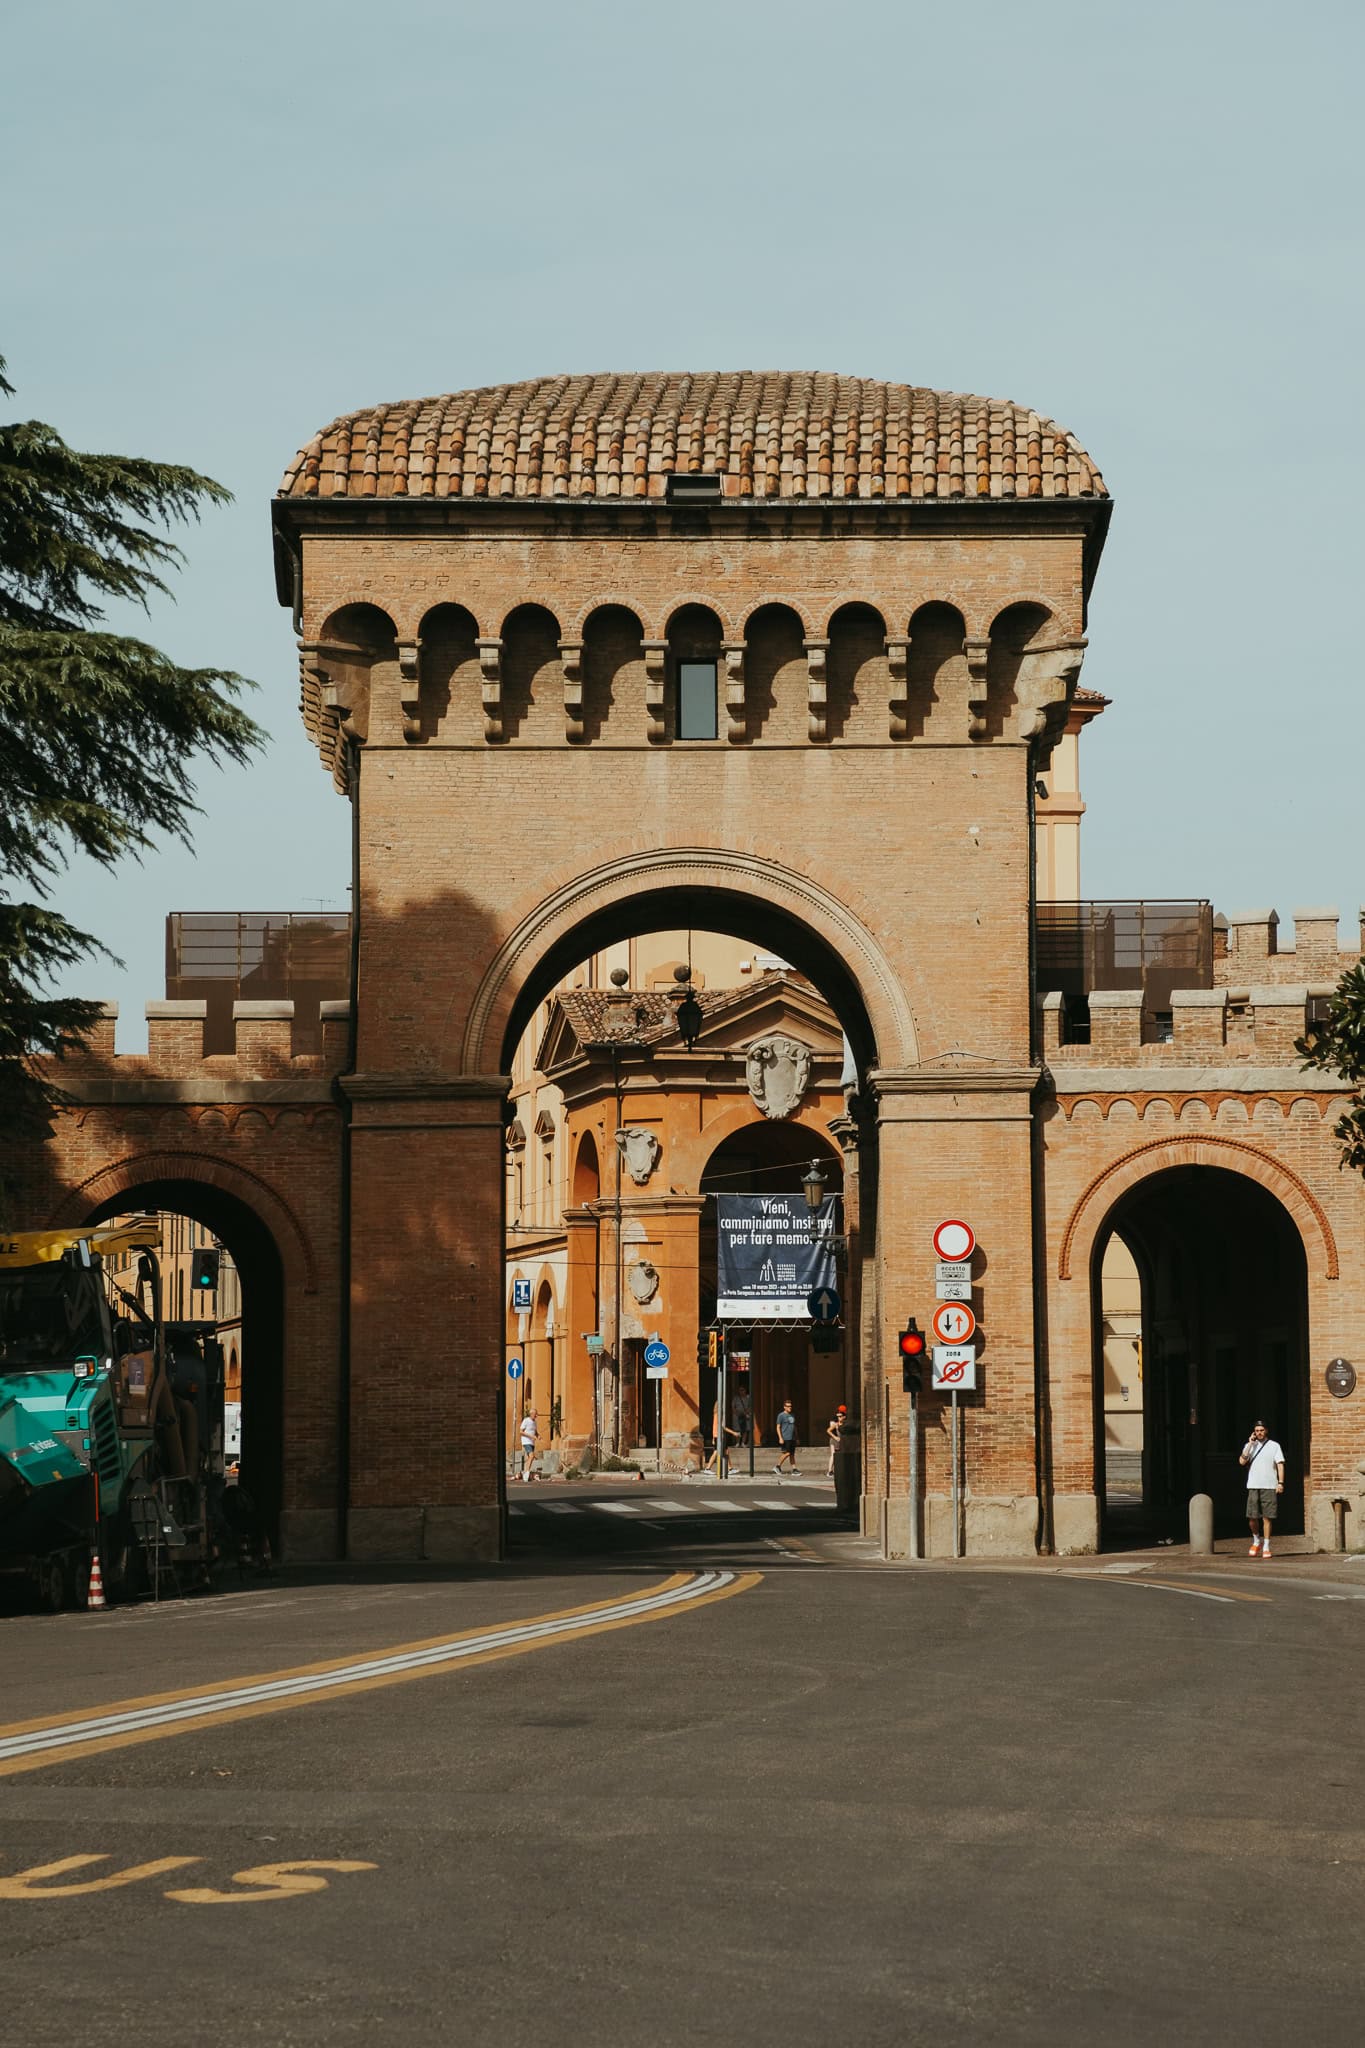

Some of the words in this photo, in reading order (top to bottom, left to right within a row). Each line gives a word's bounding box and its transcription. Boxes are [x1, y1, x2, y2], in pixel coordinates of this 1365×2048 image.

[761, 1199, 792, 1217] Vieni,
[720, 1216, 789, 1230] camminiamo
[730, 1234, 749, 1249] per
[750, 1230, 773, 1245] fare
[776, 1231, 823, 1245] memo
[0, 1853, 380, 1904] US
